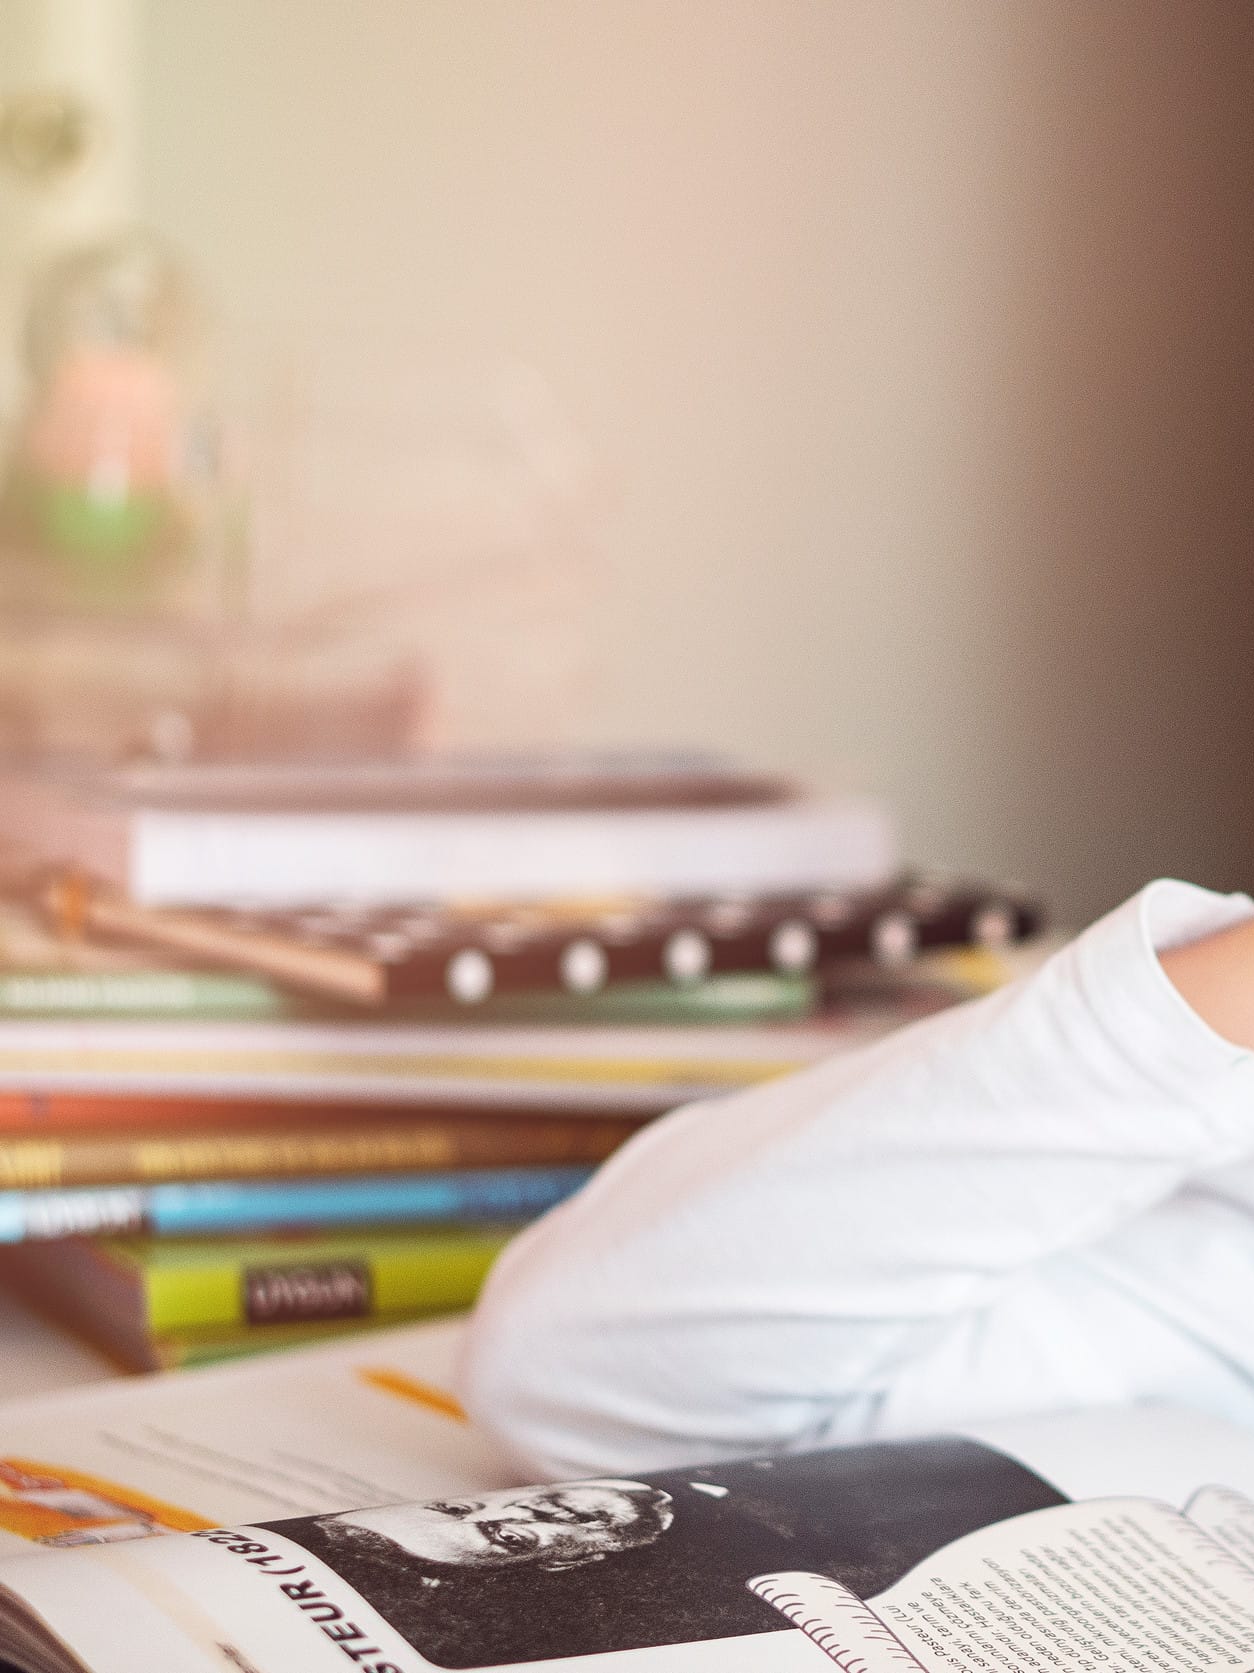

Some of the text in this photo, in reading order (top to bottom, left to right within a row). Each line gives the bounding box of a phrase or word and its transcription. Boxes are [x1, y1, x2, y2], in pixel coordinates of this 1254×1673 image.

[882, 1606, 914, 1622] (Lui
[908, 1602, 990, 1667] sanayi, tarım ve
[921, 1592, 1025, 1673] sorunlarını çözmeye
[930, 1578, 1040, 1666] adamıdır. Hastalıklara
[960, 1582, 1066, 1666] neden olduğunu fark
[983, 1559, 1109, 1661] Geliştirdiği pastörizasyon
[984, 1581, 1096, 1671] tıp dünyasında devrim
[1080, 1601, 1147, 1649] yiyeceklerin
[1128, 1620, 1144, 1629] ve
[906, 1625, 951, 1656] Pasteur
[1148, 1616, 1217, 1666] Hastalıkların
[1196, 1633, 1243, 1664] Bulduğu
[1209, 1625, 1253, 1653] aşılama
